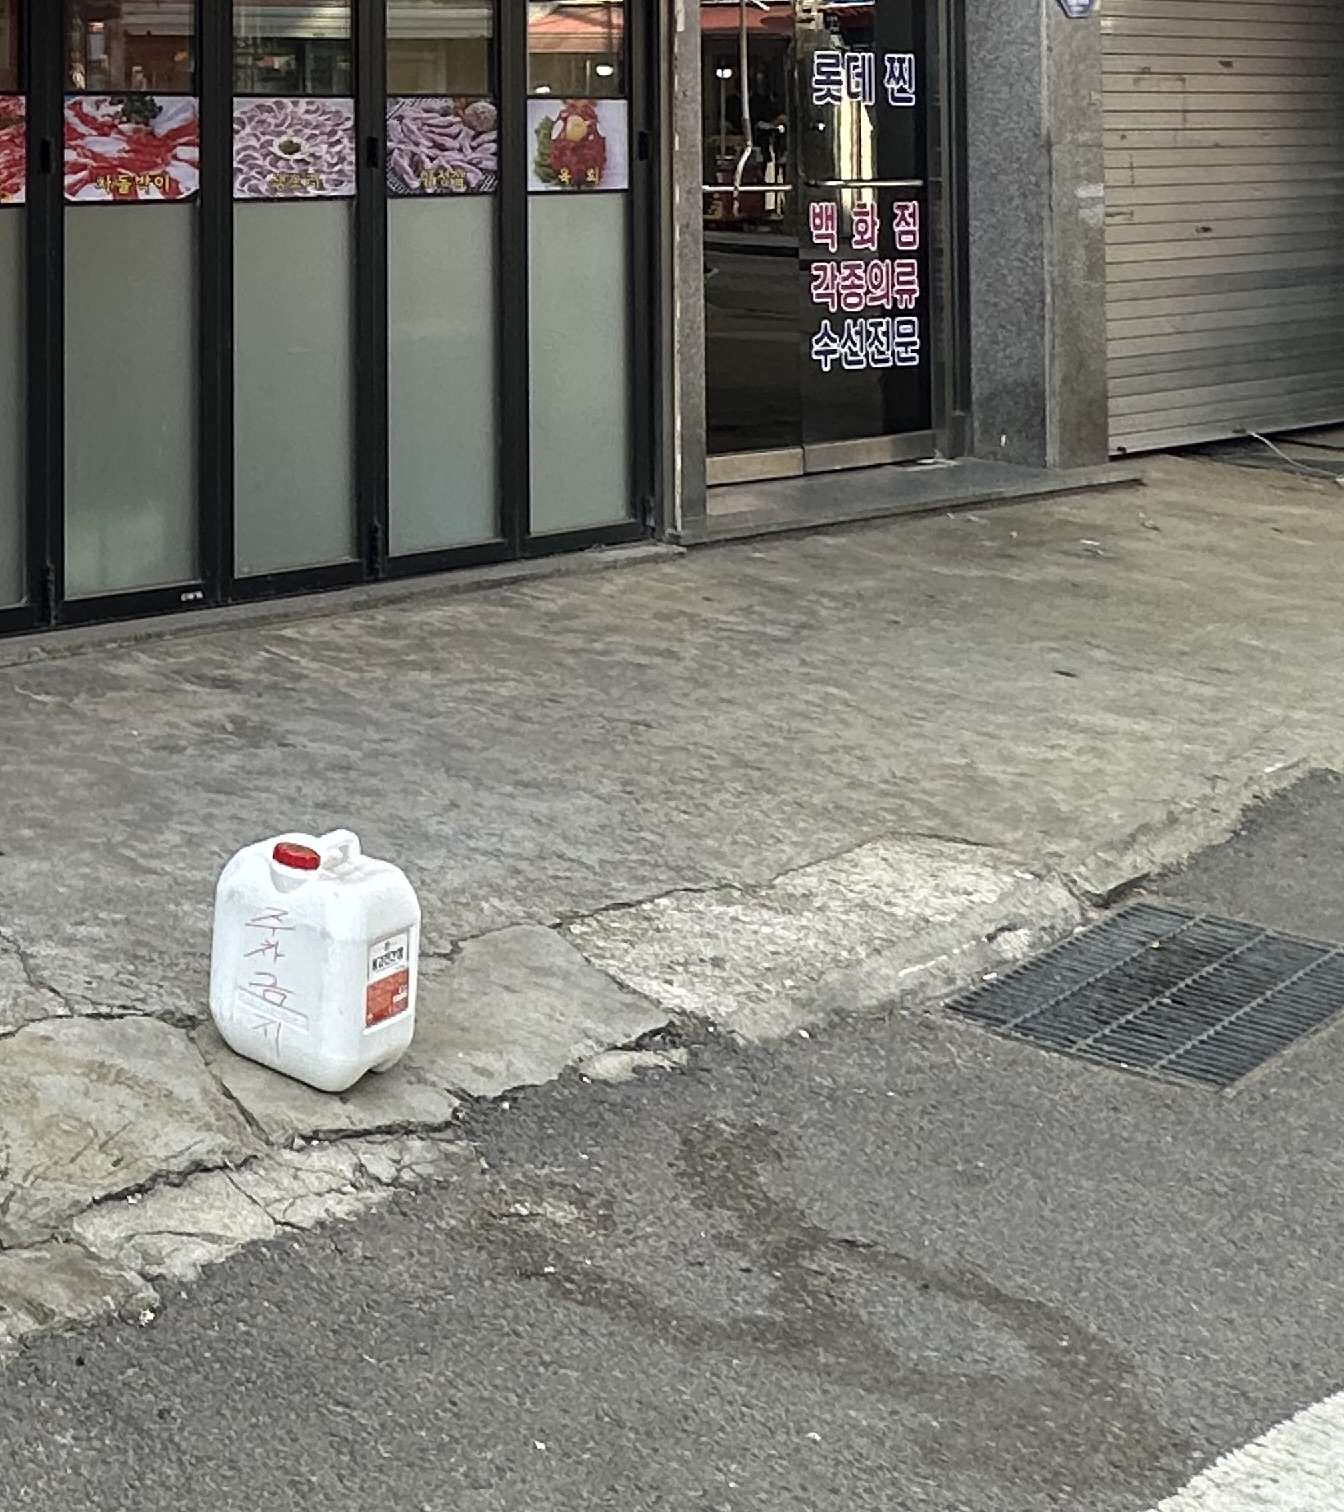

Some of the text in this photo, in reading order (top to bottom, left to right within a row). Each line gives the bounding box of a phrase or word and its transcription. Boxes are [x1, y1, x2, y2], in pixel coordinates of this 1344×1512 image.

[812, 50, 916, 107] 롯데 찐
[95, 174, 171, 200] 차돌박이
[811, 259, 920, 312] 각종의류
[811, 317, 920, 372] 수선전문
